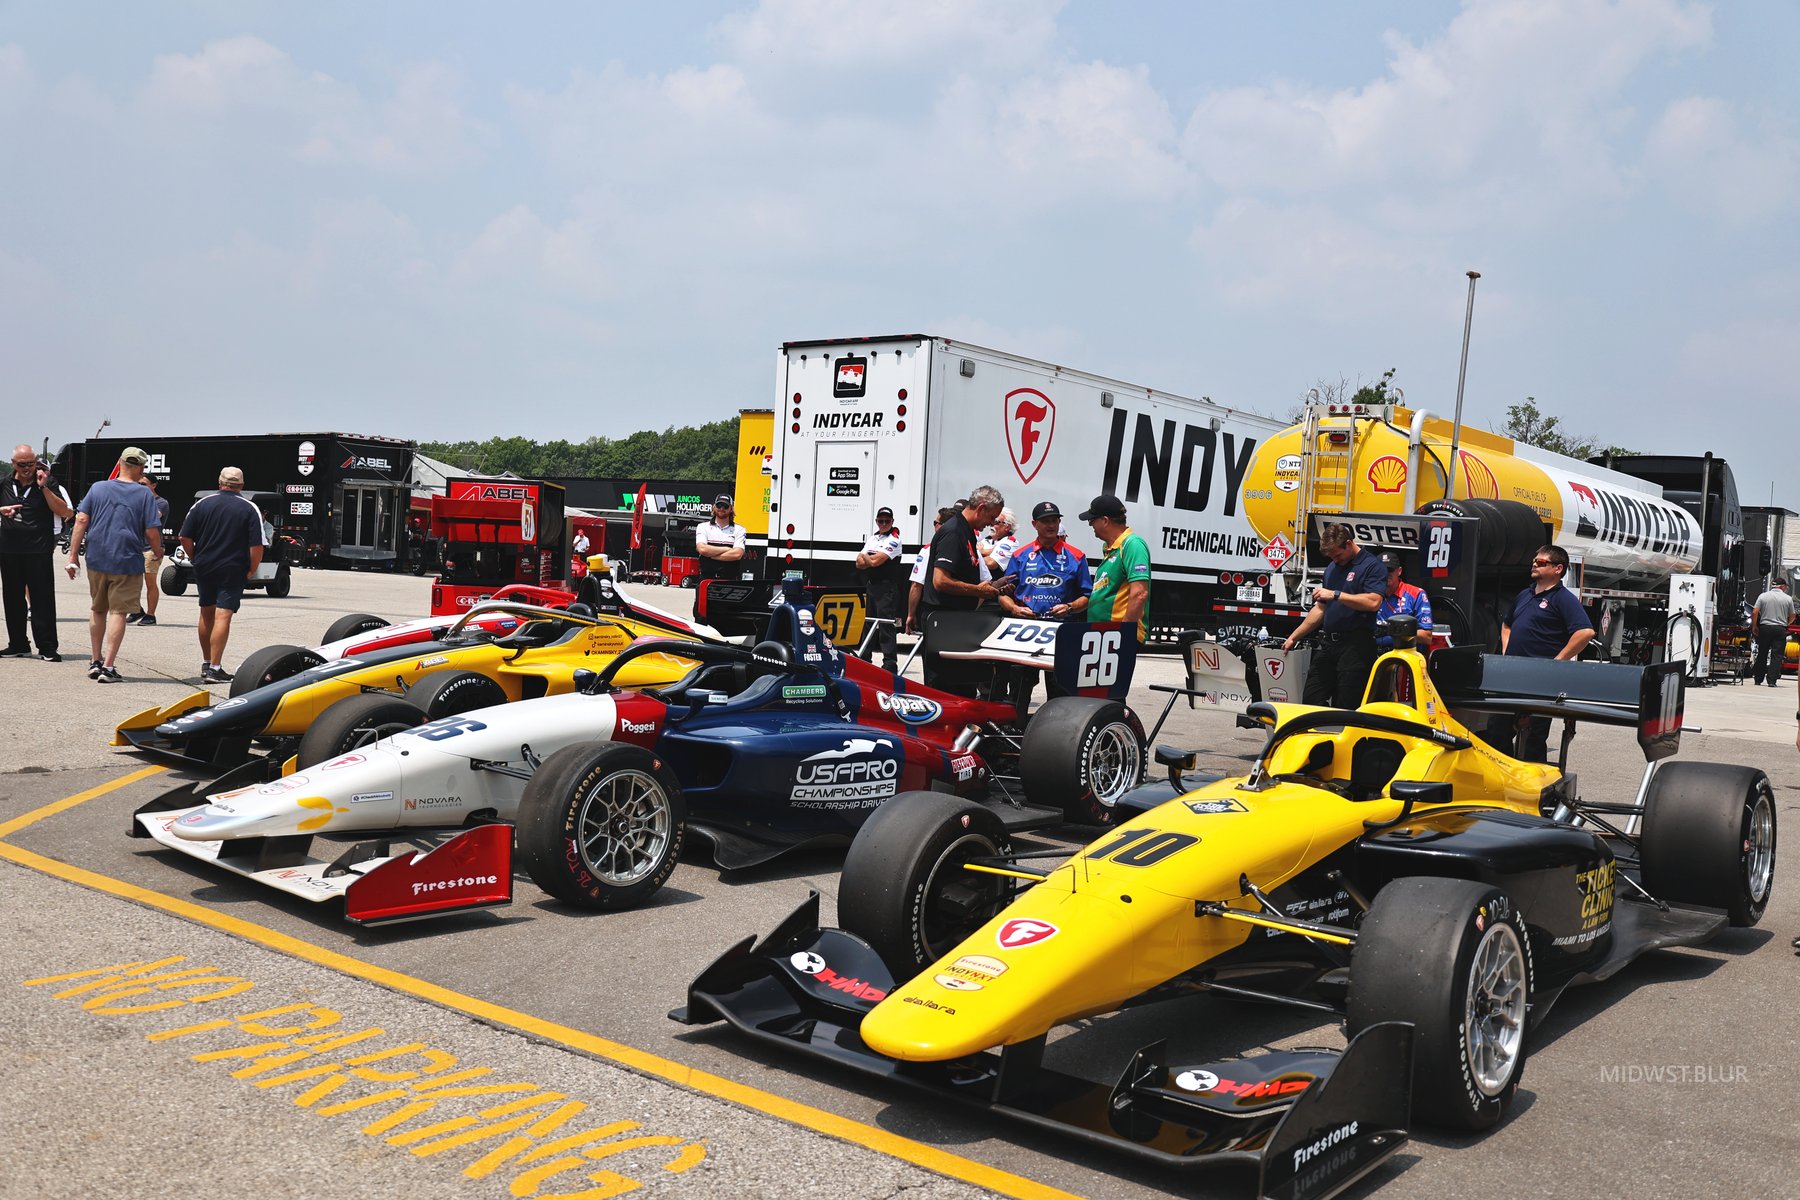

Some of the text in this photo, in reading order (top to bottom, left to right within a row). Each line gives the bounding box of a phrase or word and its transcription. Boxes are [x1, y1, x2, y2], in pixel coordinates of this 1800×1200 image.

[813, 412, 883, 428] INDYCAR
[143, 454, 170, 473] BEL
[357, 457, 392, 468] ABEL
[1102, 408, 1256, 516] INDY
[482, 488, 534, 500] ABEL
[1245, 489, 1272, 499] 3906
[676, 503, 712, 511] HOLLINGER
[1594, 488, 1690, 557] INDYCAR
[1162, 526, 1233, 555] TECHNICAL
[1419, 525, 1443, 564] 26
[1268, 550, 1285, 558] 3475
[1025, 576, 1058, 586] Copart
[823, 602, 854, 640] 57
[752, 653, 787, 666] Firestone
[804, 653, 822, 662] FOSTER
[1078, 630, 1122, 688] 26
[439, 678, 476, 702] Firestone
[876, 690, 936, 716] Copart
[621, 718, 656, 734] Poggesi
[1432, 728, 1456, 743] Firestone
[1080, 726, 1097, 786] Firestone
[796, 759, 898, 784] USFPRO
[419, 796, 462, 804] NOVARA
[565, 766, 602, 831] Firestone
[794, 782, 894, 799] CHAMPIONSHIPS
[790, 800, 860, 810] SCHOLARSHIP
[653, 820, 684, 886] Firestone
[1088, 828, 1201, 866] 10
[412, 875, 498, 896] Firestone
[1576, 872, 1587, 884] THE
[912, 882, 924, 964] Firestone
[1587, 916, 1598, 929] LAW
[1552, 935, 1578, 945] MIAMI
[1578, 934, 1586, 943] TO
[1586, 930, 1596, 941] LOS
[1516, 910, 1535, 994] Firestone
[814, 967, 887, 1002] HMD
[904, 996, 957, 1016] dallara
[1459, 1022, 1480, 1112] Firestone
[24, 955, 709, 1200] NO PARKING
[1211, 1078, 1311, 1097] HMD
[1294, 1120, 1358, 1172] Firestone
